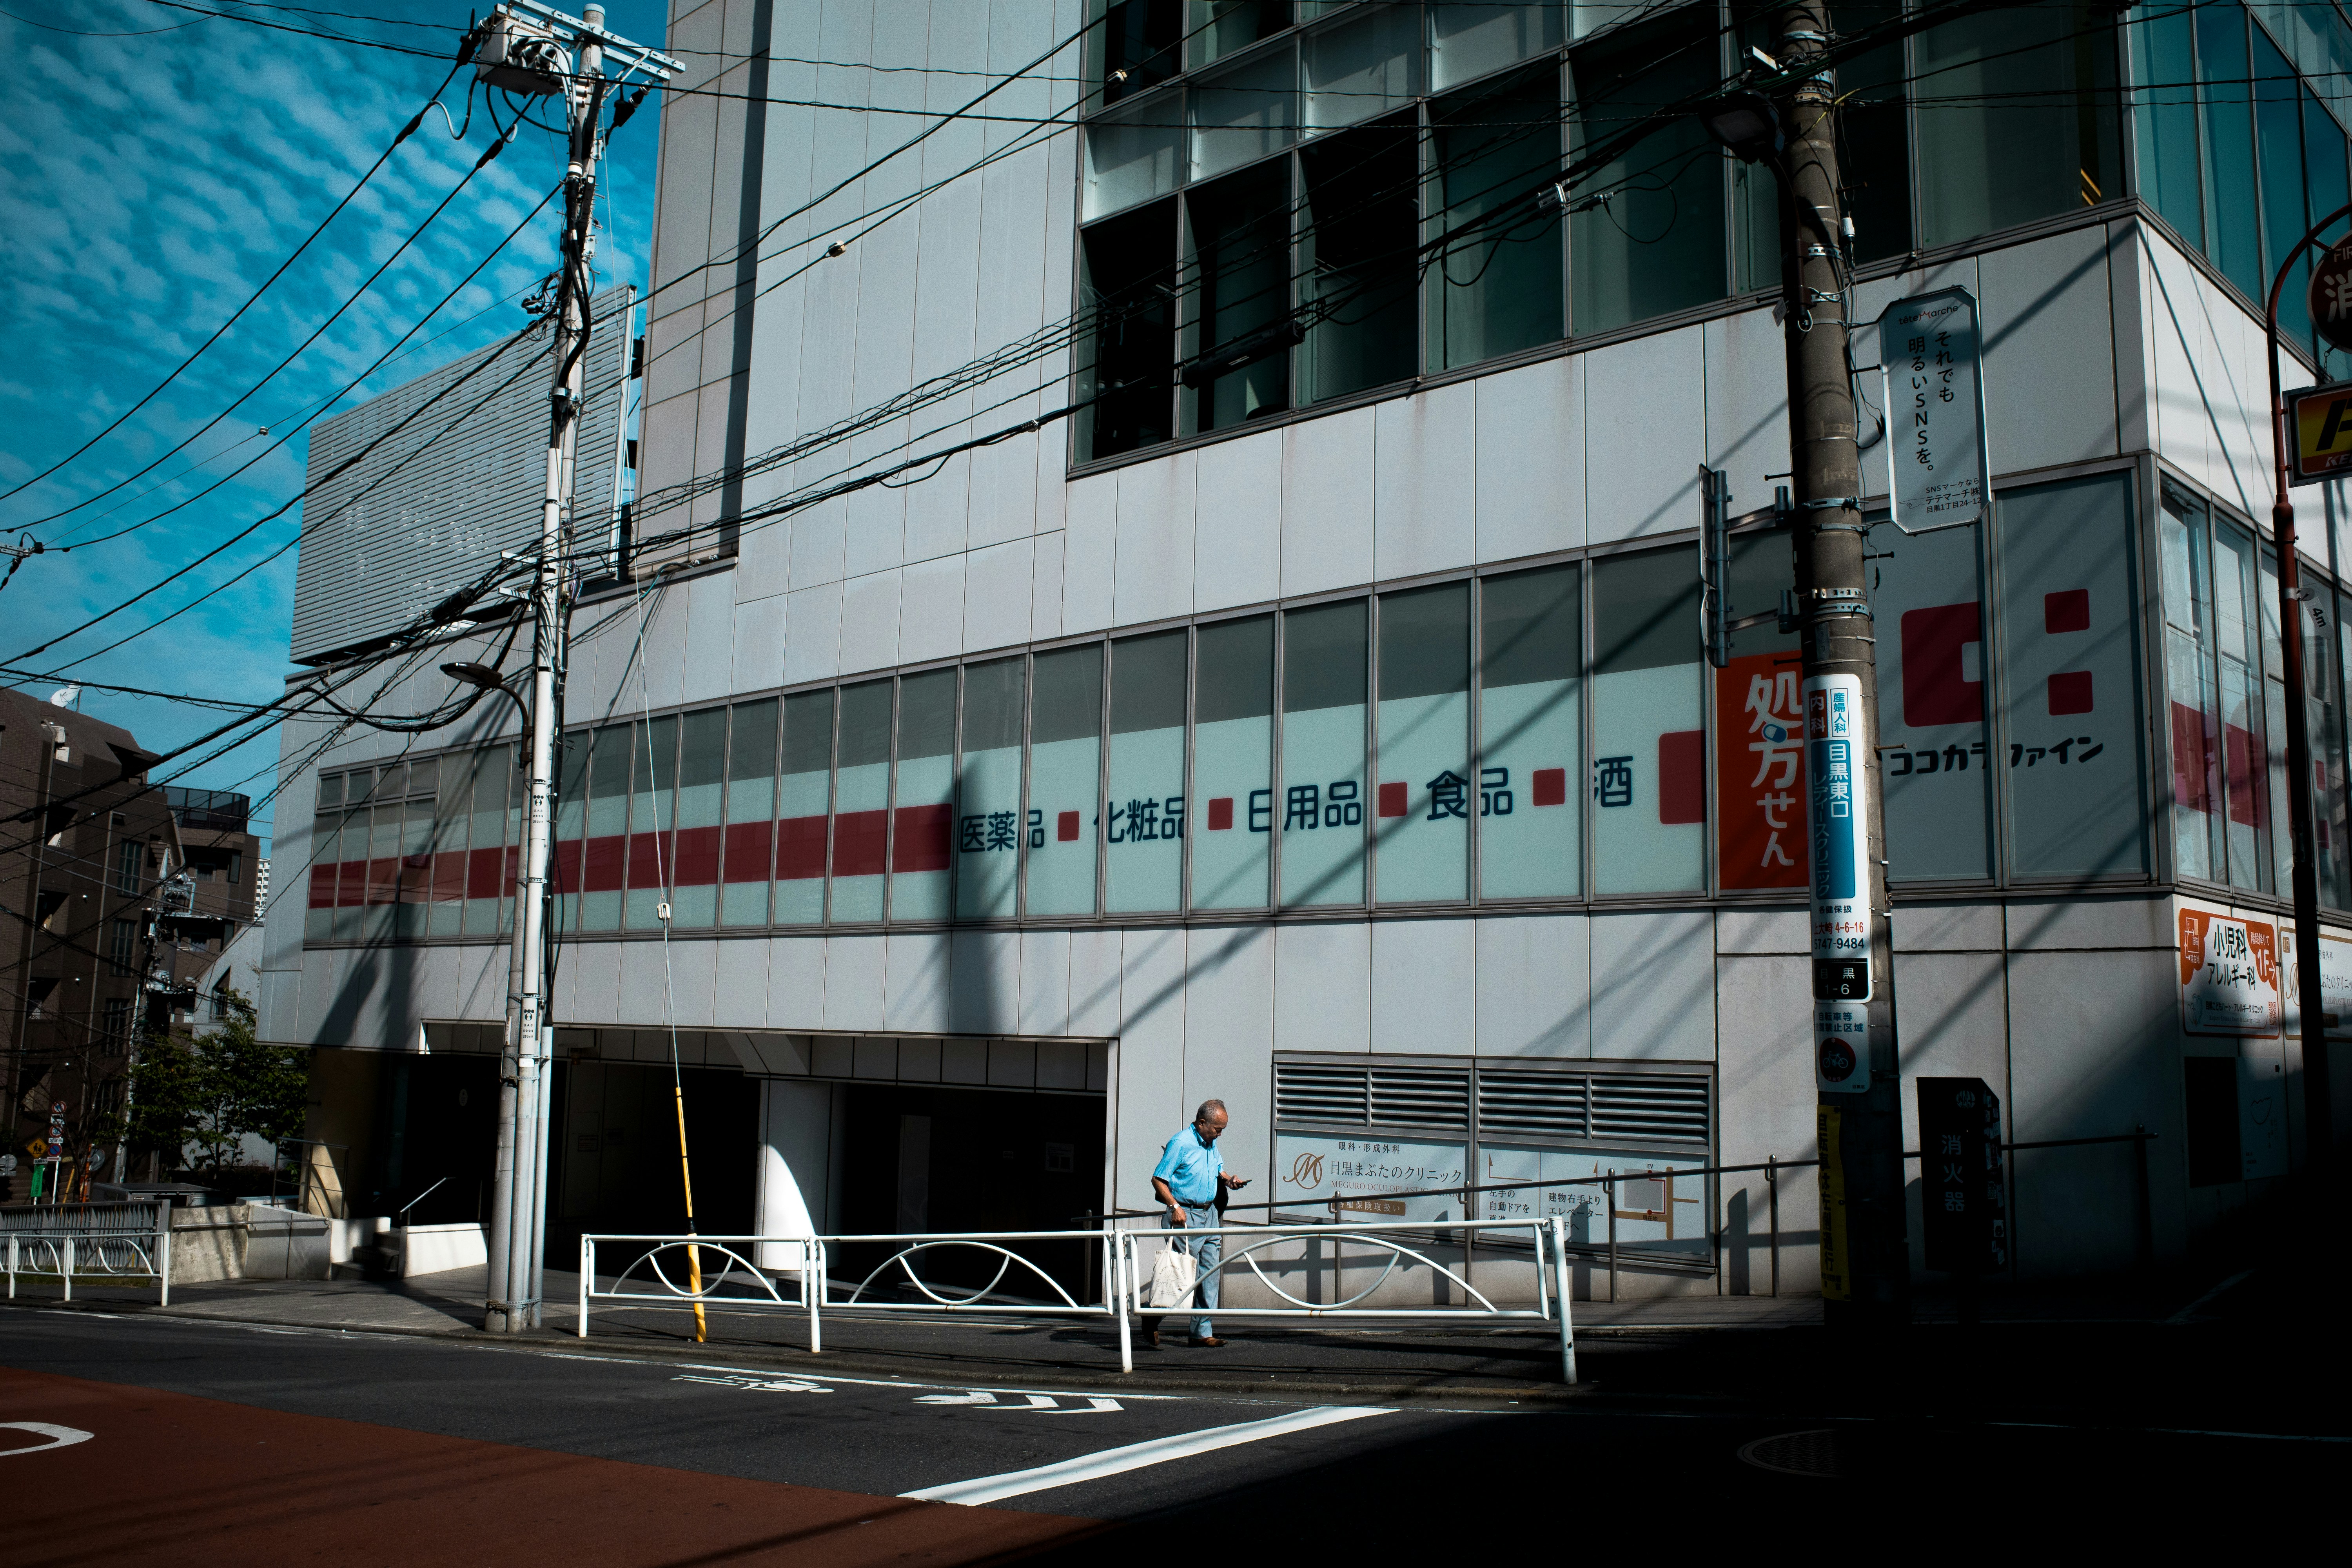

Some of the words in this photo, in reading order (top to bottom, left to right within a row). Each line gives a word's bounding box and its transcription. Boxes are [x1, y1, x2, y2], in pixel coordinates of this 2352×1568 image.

[1935, 330, 1954, 403] それでも
[1908, 336, 1934, 471] 明るいSNSを。
[1926, 477, 1980, 494] SNSマーケなら
[2312, 608, 2327, 628] 4m
[1809, 695, 1826, 733] 内科
[1833, 692, 1847, 734] 産婦人科
[1890, 737, 2104, 776] ココカラファイン
[1828, 744, 1849, 818] 目黒東口
[959, 809, 1045, 852] 医薬品
[1093, 797, 1187, 844] 化粧品
[1248, 780, 1362, 833] 日用品
[1426, 768, 1513, 821] 食品
[1591, 755, 1633, 808] 酒
[1813, 771, 1830, 897] レディースクリニック
[1819, 905, 1852, 914] 各健保扱
[1835, 921, 1864, 933] 4-6-16
[1814, 937, 1865, 950] 5747-9484
[2213, 924, 2247, 961] 小児科
[2250, 931, 2270, 946] 階段降りて
[2283, 938, 2289, 951] 1F
[2190, 955, 2200, 964] 現在地
[2257, 948, 2269, 977] 1F
[1821, 968, 1855, 980] 目黒
[2207, 962, 2256, 991] アレルギー科
[1825, 984, 1850, 995] 1-6
[1819, 1012, 1853, 1021] 自転車等
[1331, 1160, 1462, 1183] 目黒まぶたのクリニック
[1941, 1134, 1965, 1212] 消火器
[1331, 1180, 1365, 1190] MEGURO
[1489, 1201, 1530, 1214] 自動ドアを
[1548, 1192, 1601, 1206] 建物右手より
[1548, 1207, 1604, 1219] エレベーター
